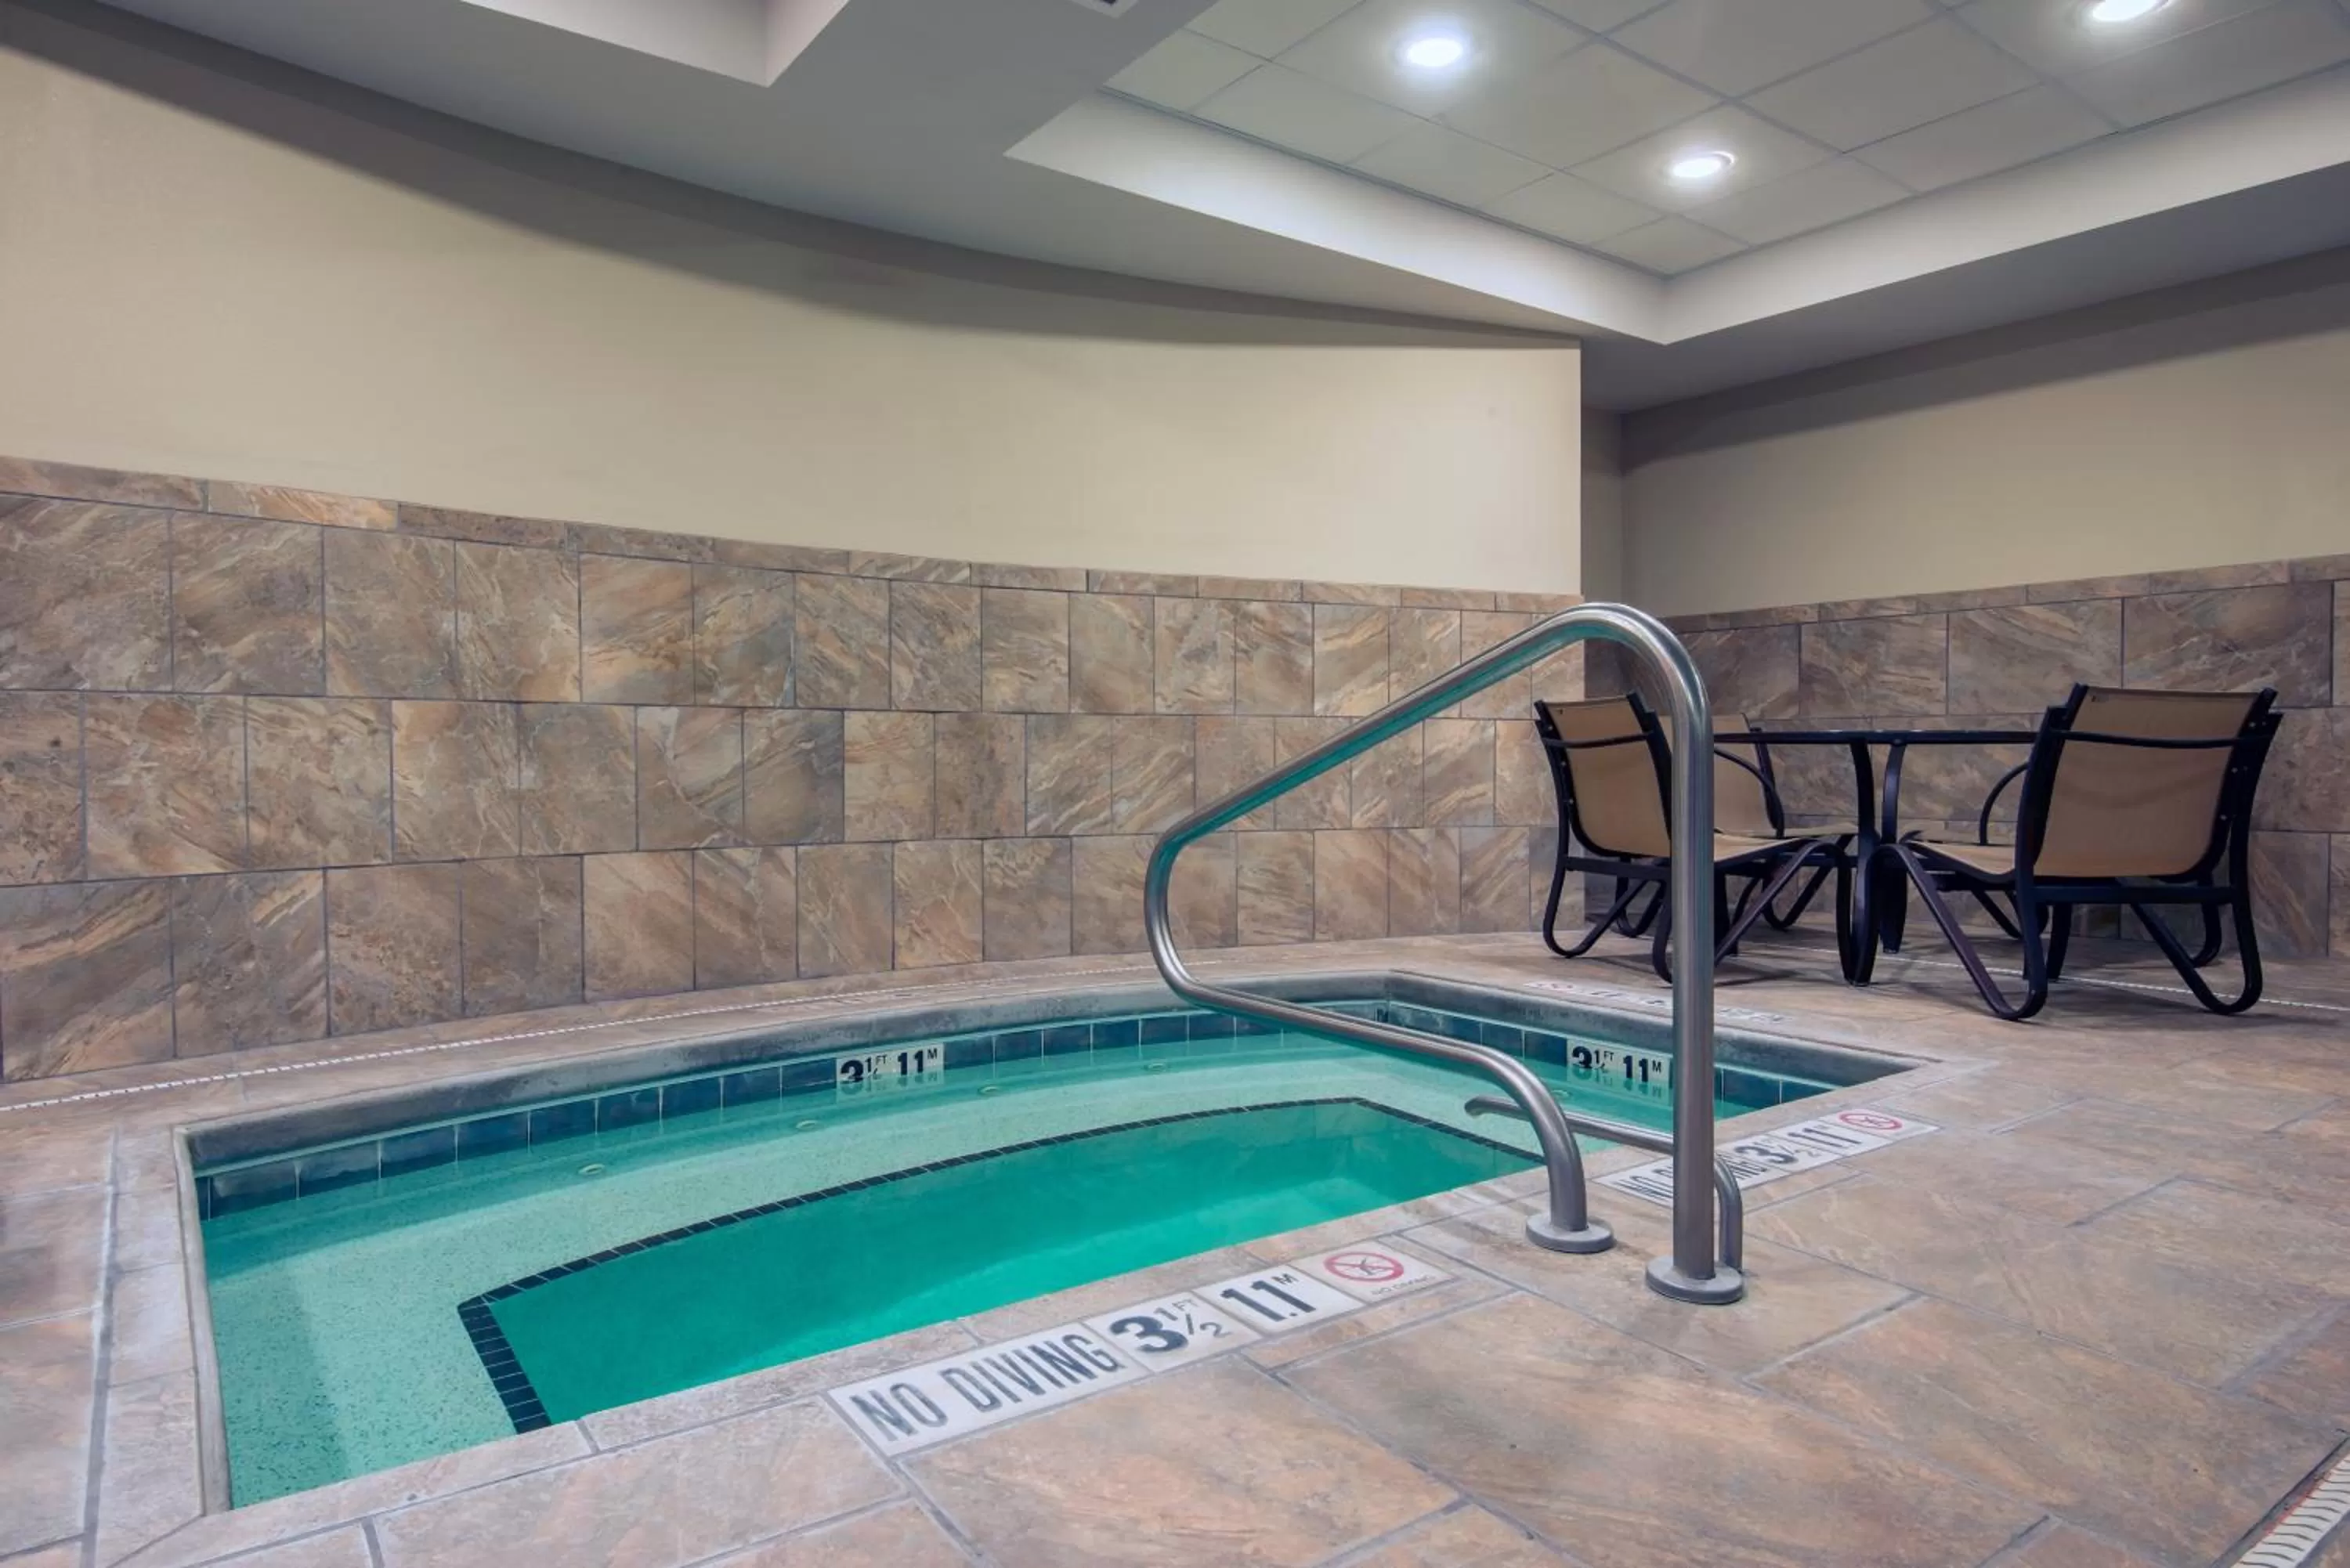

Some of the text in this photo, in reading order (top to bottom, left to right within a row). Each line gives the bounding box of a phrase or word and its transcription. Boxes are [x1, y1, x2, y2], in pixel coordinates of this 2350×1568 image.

[849, 1382, 949, 1442] NO
[938, 1334, 1126, 1413] DIVING
[1109, 1315, 1188, 1353] 3
